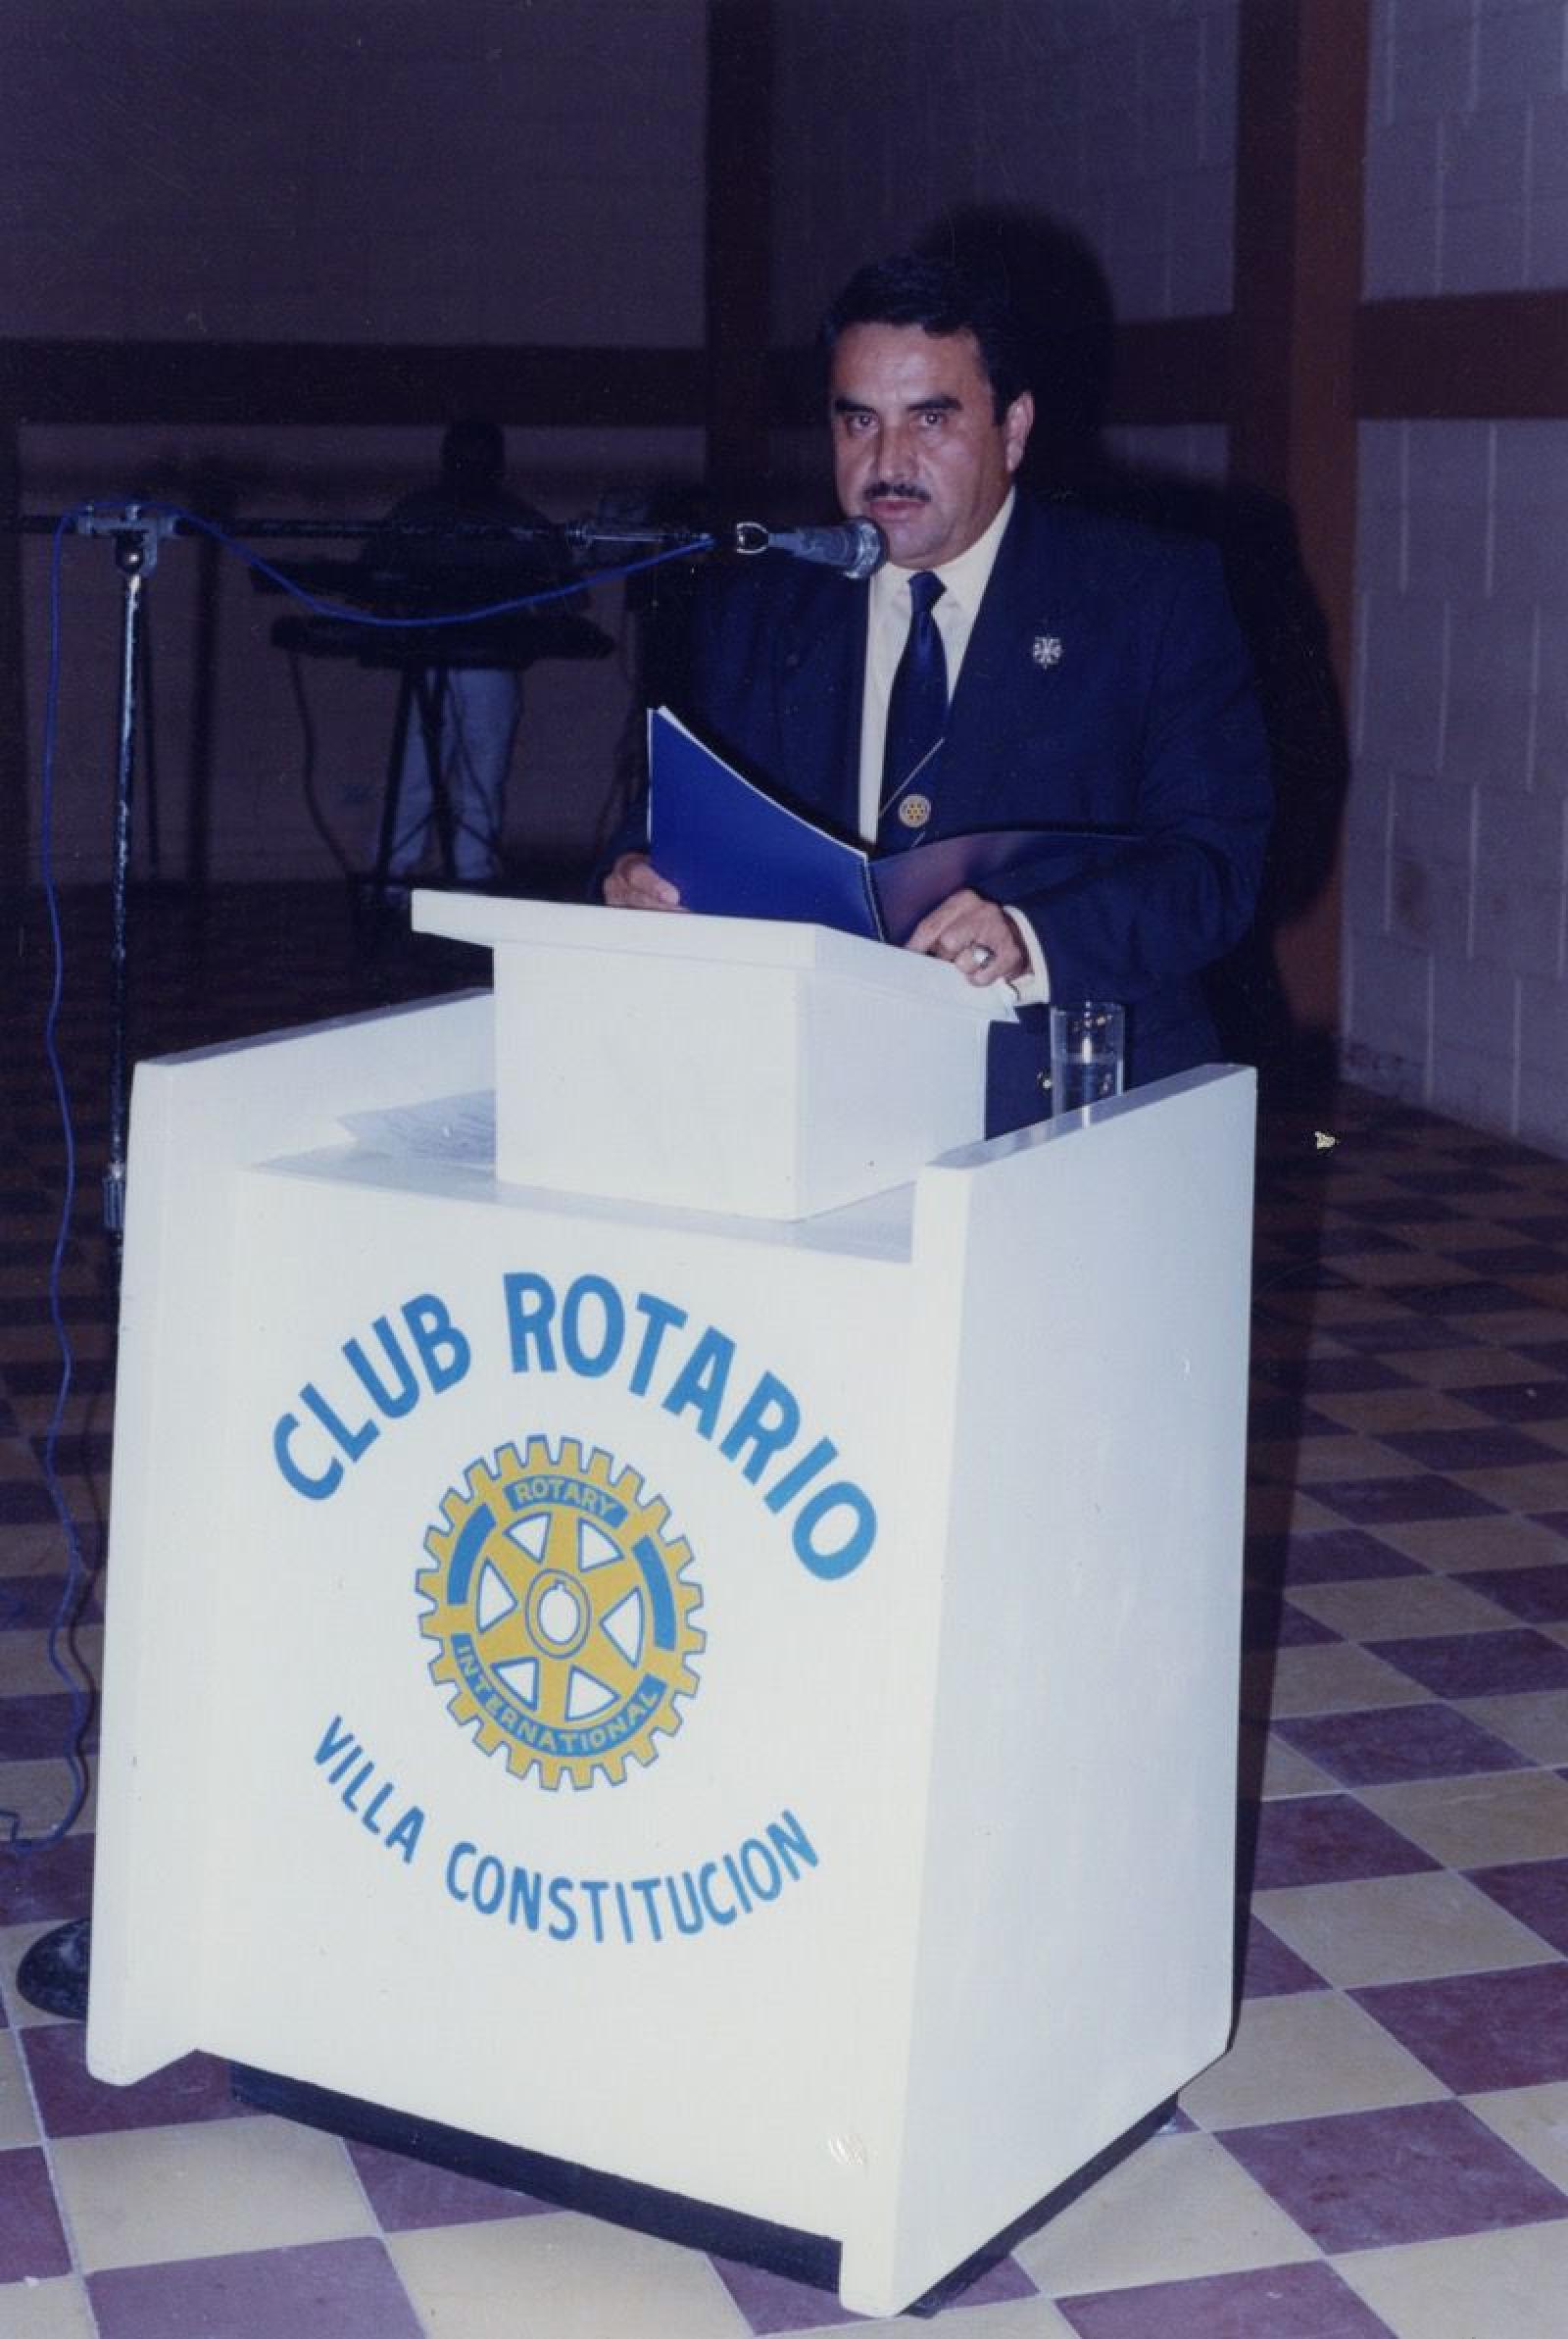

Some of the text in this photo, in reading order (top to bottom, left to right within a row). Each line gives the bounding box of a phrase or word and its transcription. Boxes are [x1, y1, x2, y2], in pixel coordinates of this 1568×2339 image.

[273, 1271, 877, 1580] CLUB ROTARIO
[514, 1477, 615, 1516] ROTARY
[456, 1643, 659, 1753] INTERNATIONAL
[314, 1716, 818, 1943] VILLA CONSTITUCION
